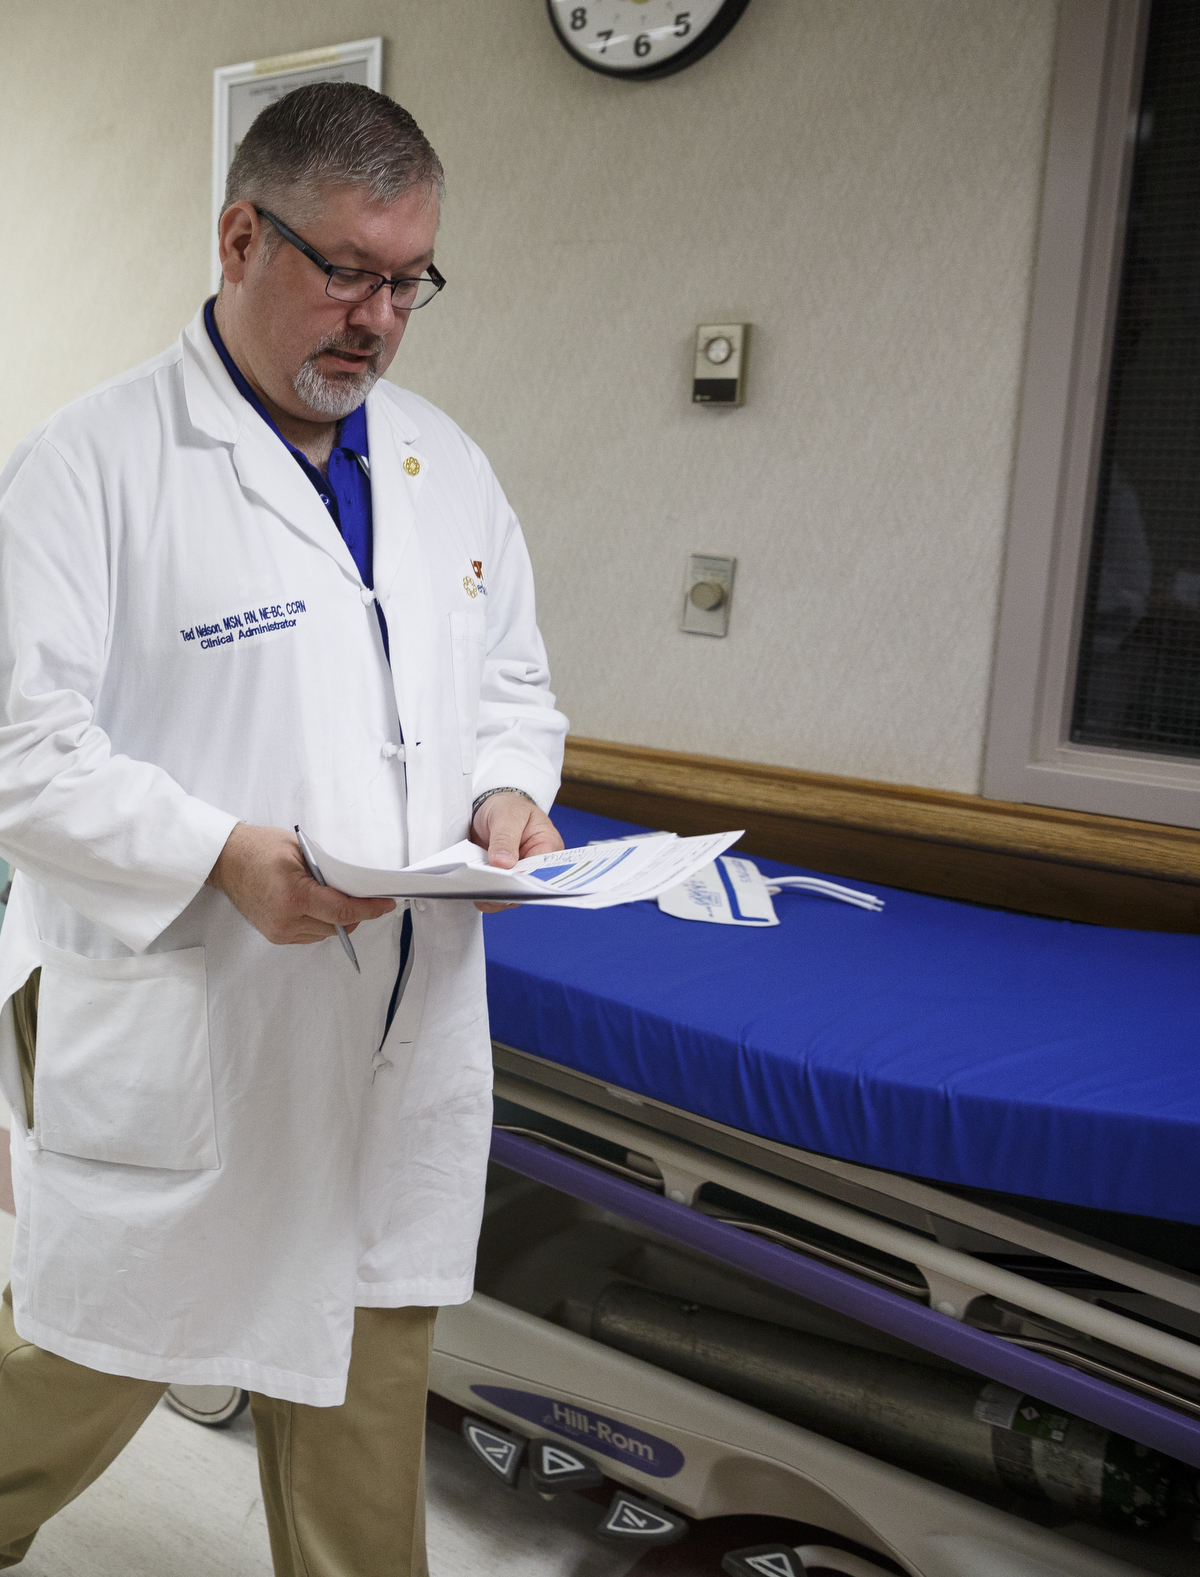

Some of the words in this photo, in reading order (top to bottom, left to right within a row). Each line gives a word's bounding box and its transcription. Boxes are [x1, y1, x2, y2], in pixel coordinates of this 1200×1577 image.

[570, 6, 587, 31] 8
[672, 11, 691, 37] 5
[596, 28, 613, 54] 7
[633, 33, 651, 57] 6
[180, 628, 195, 642] Ted
[285, 600, 307, 616] CCRN
[200, 632, 235, 650] Clinical
[238, 619, 298, 640] Administrator
[552, 1403, 655, 1462] Hill-Rom
